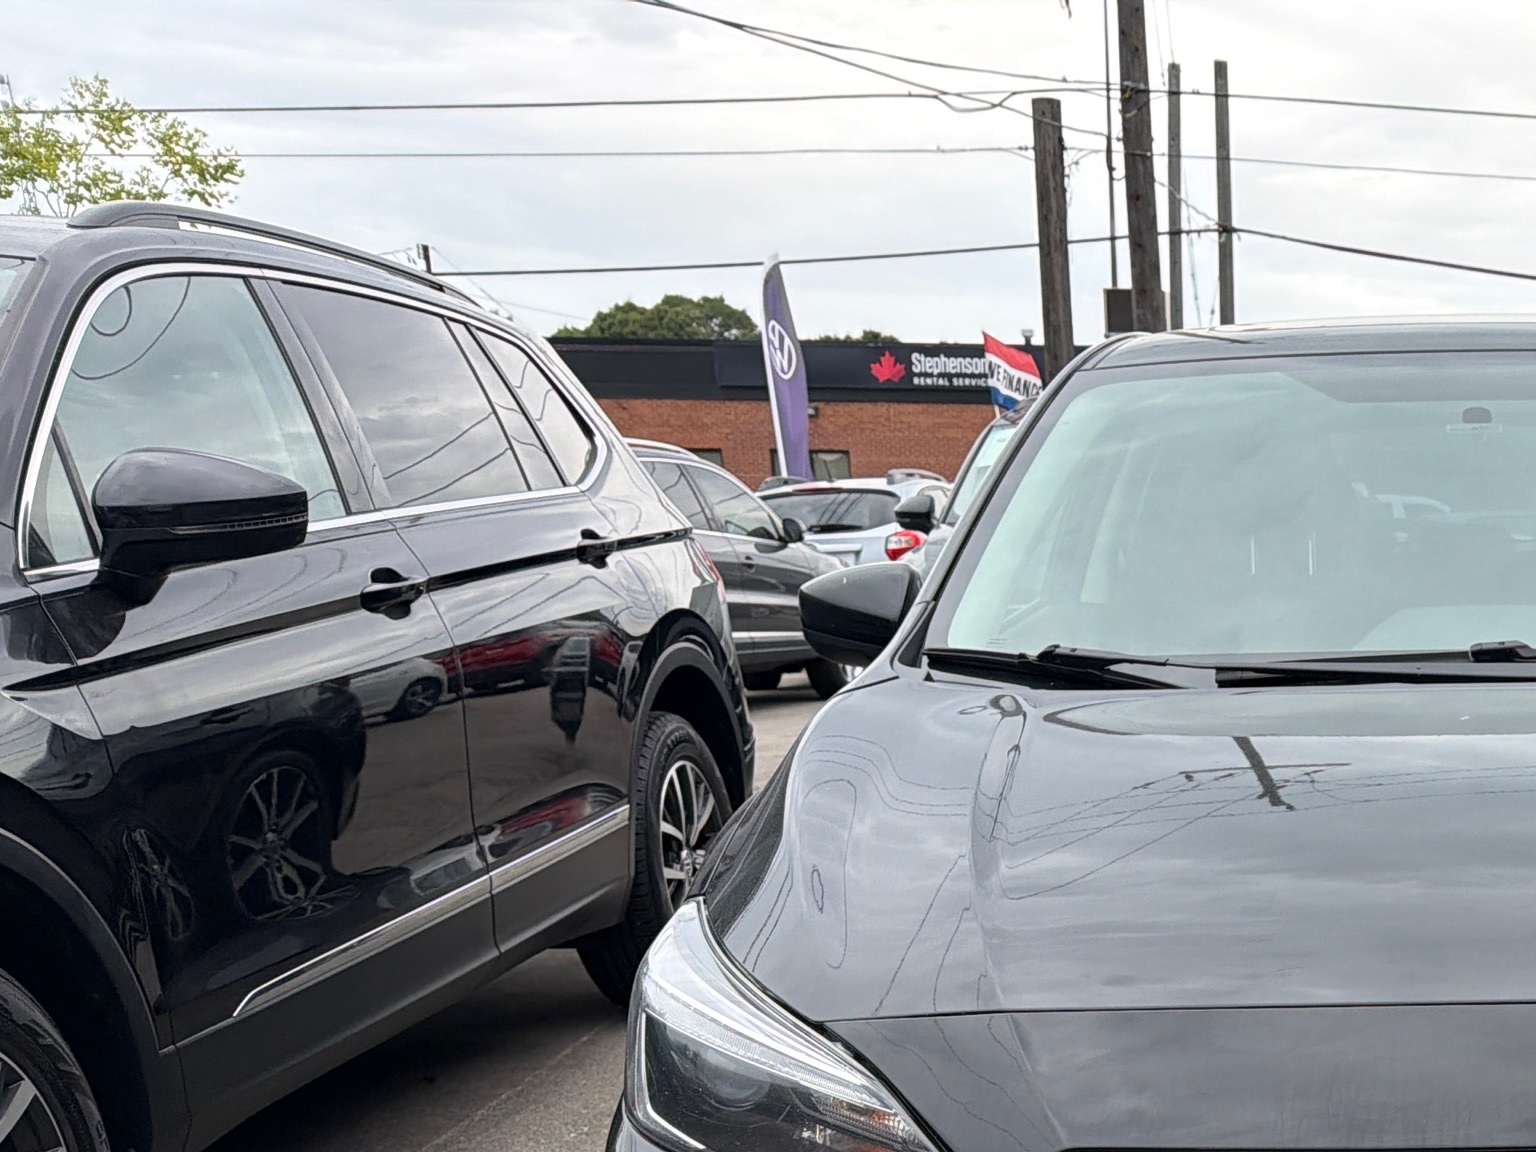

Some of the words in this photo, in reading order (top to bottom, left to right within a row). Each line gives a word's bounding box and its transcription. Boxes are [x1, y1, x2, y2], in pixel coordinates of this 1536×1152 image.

[911, 352, 989, 375] Stephenson
[913, 376, 950, 386] RENTAL
[952, 377, 989, 387] SERVIC
[1002, 368, 1042, 398] FINANC
